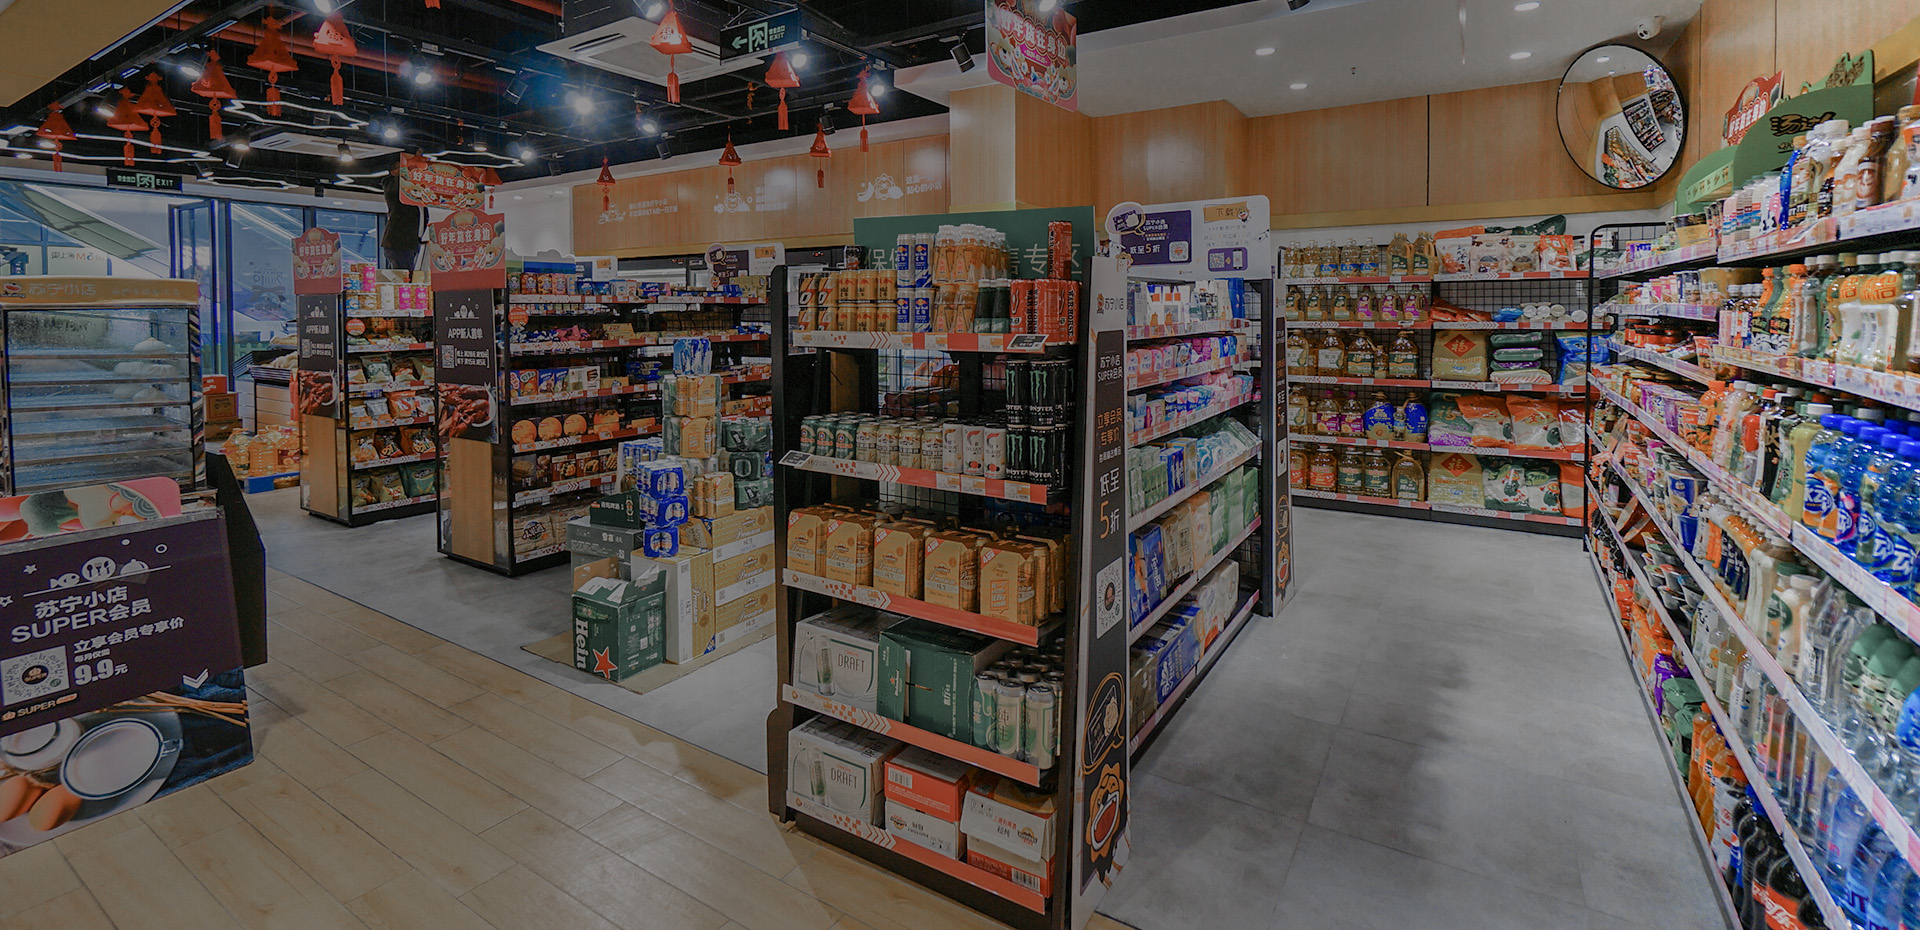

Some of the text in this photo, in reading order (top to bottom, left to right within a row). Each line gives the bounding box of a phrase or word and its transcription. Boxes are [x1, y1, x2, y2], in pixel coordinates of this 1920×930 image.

[769, 32, 784, 41] EXIT
[156, 179, 173, 187] EXIT
[28, 282, 97, 297] 苏宁小店
[1100, 355, 1121, 370] 苏宁小店
[1097, 366, 1123, 383] SUPER会员
[1097, 407, 1122, 430] 立享会员
[1100, 466, 1121, 498] 低至
[1100, 499, 1121, 539] 5折
[34, 585, 129, 620] 苏宁小店
[11, 598, 152, 644] SUPER会员
[73, 616, 185, 654] 立享会员专享价
[73, 658, 129, 686] 9.9元
[838, 653, 865, 673] DRAFT
[17, 700, 57, 717] SUPER
[831, 767, 858, 789] DRAFT
